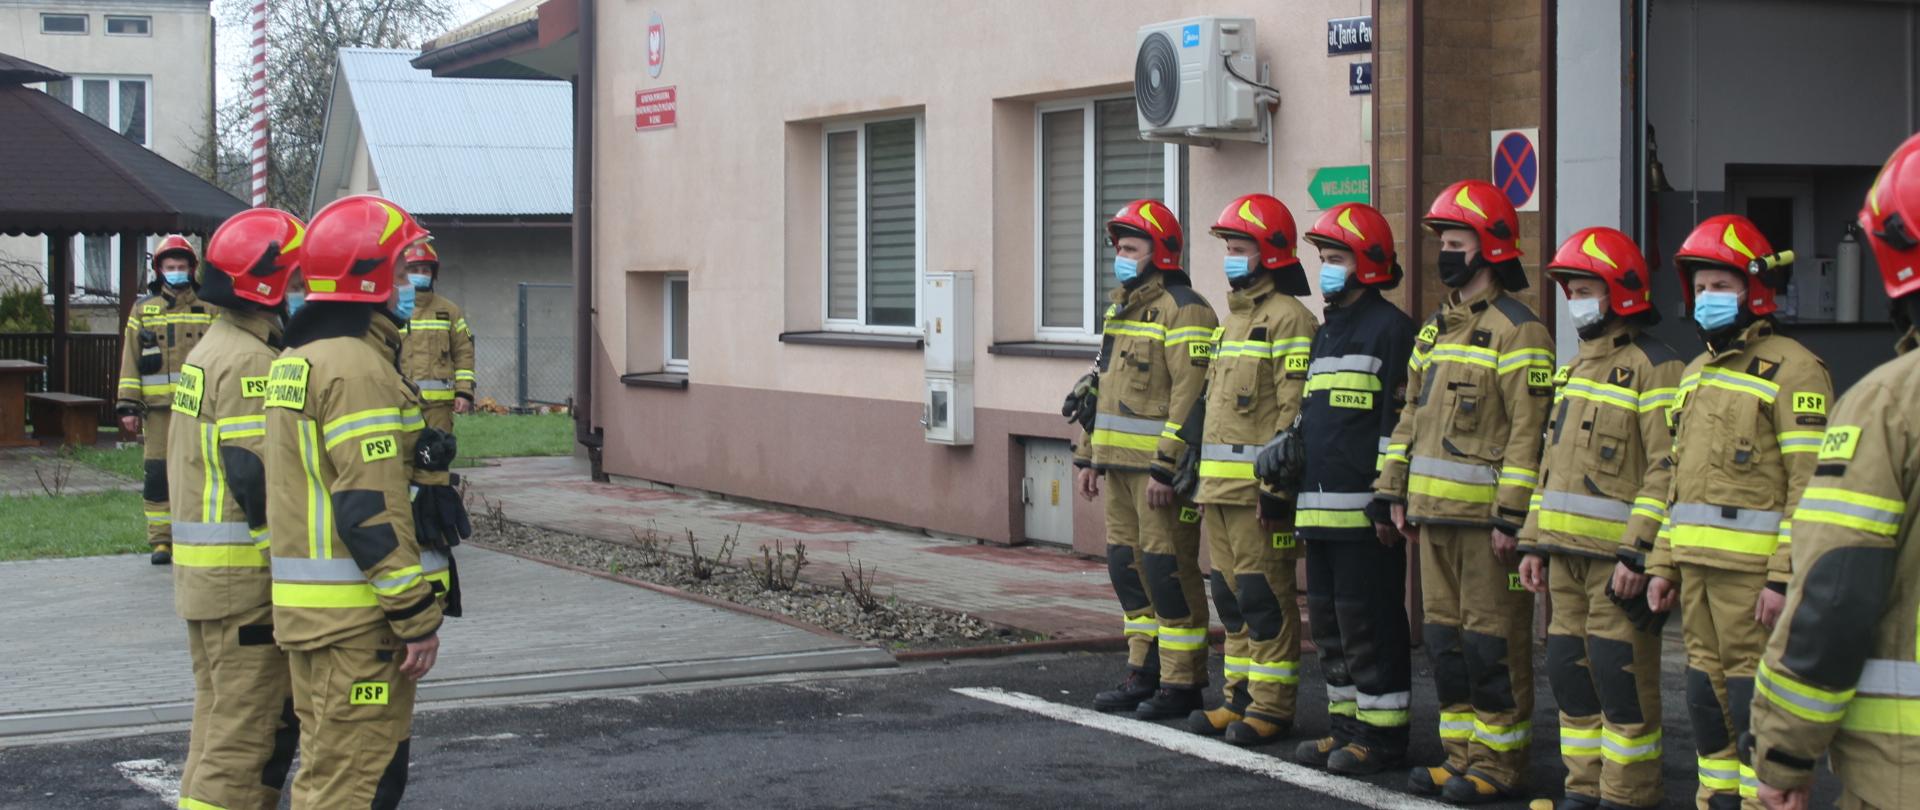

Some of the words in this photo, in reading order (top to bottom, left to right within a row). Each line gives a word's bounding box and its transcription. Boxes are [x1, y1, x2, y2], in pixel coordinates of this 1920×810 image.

[1338, 24, 1357, 49] Jana
[1356, 65, 1363, 84] 2
[1321, 176, 1369, 195] WEJŚCIE
[1530, 371, 1548, 383] PSP
[1797, 396, 1822, 409] PSP
[366, 439, 391, 456] PSP
[1823, 431, 1849, 452] PSP
[355, 686, 384, 700] PSP
